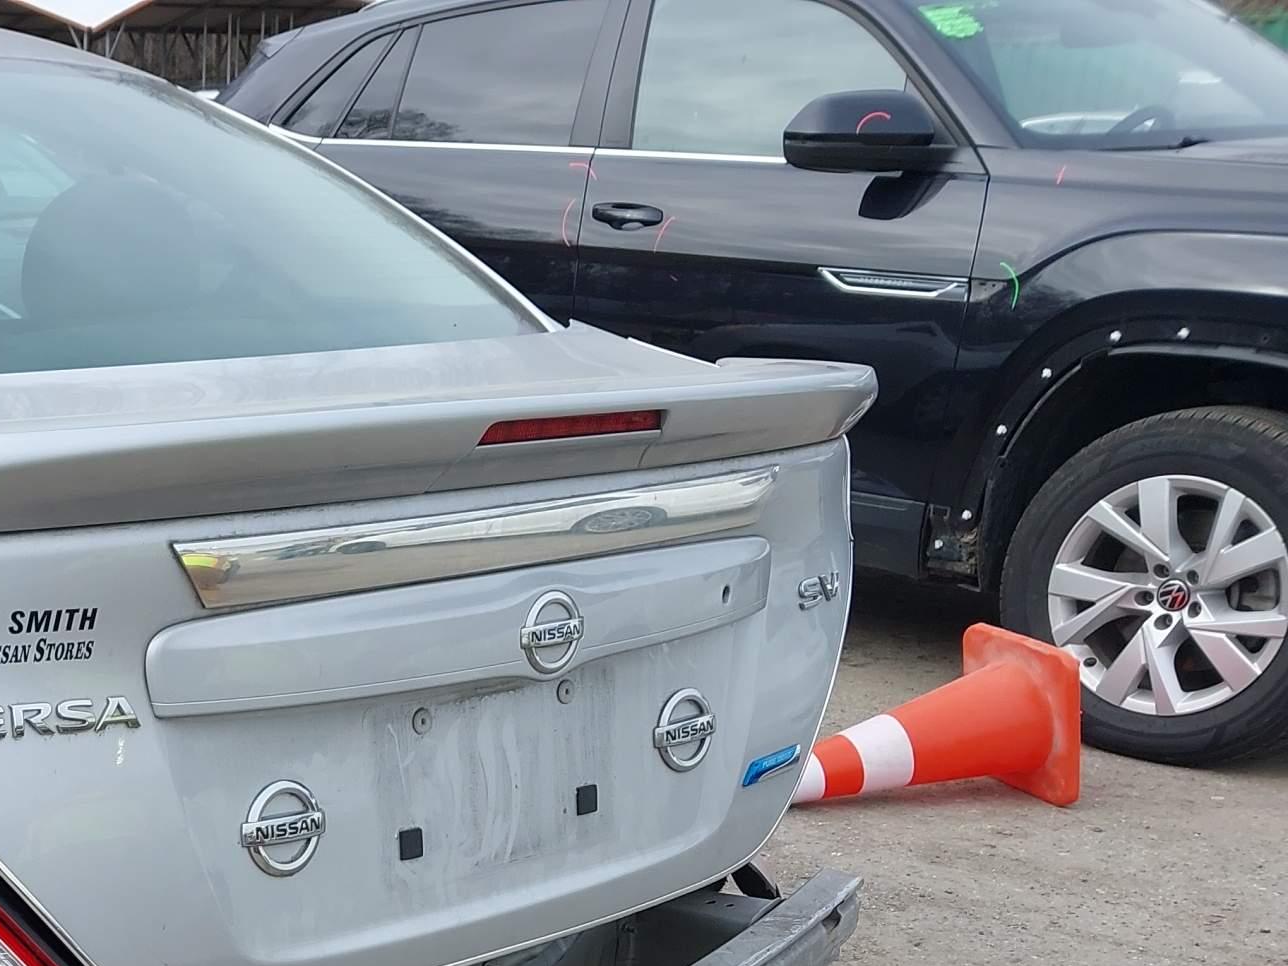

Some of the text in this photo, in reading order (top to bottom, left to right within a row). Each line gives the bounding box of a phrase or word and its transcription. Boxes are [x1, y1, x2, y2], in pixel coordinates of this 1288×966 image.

[8, 607, 98, 633] SMITH
[531, 623, 581, 643] NISSAN
[665, 718, 715, 743] NISSAN
[255, 816, 321, 842] NISSAN
